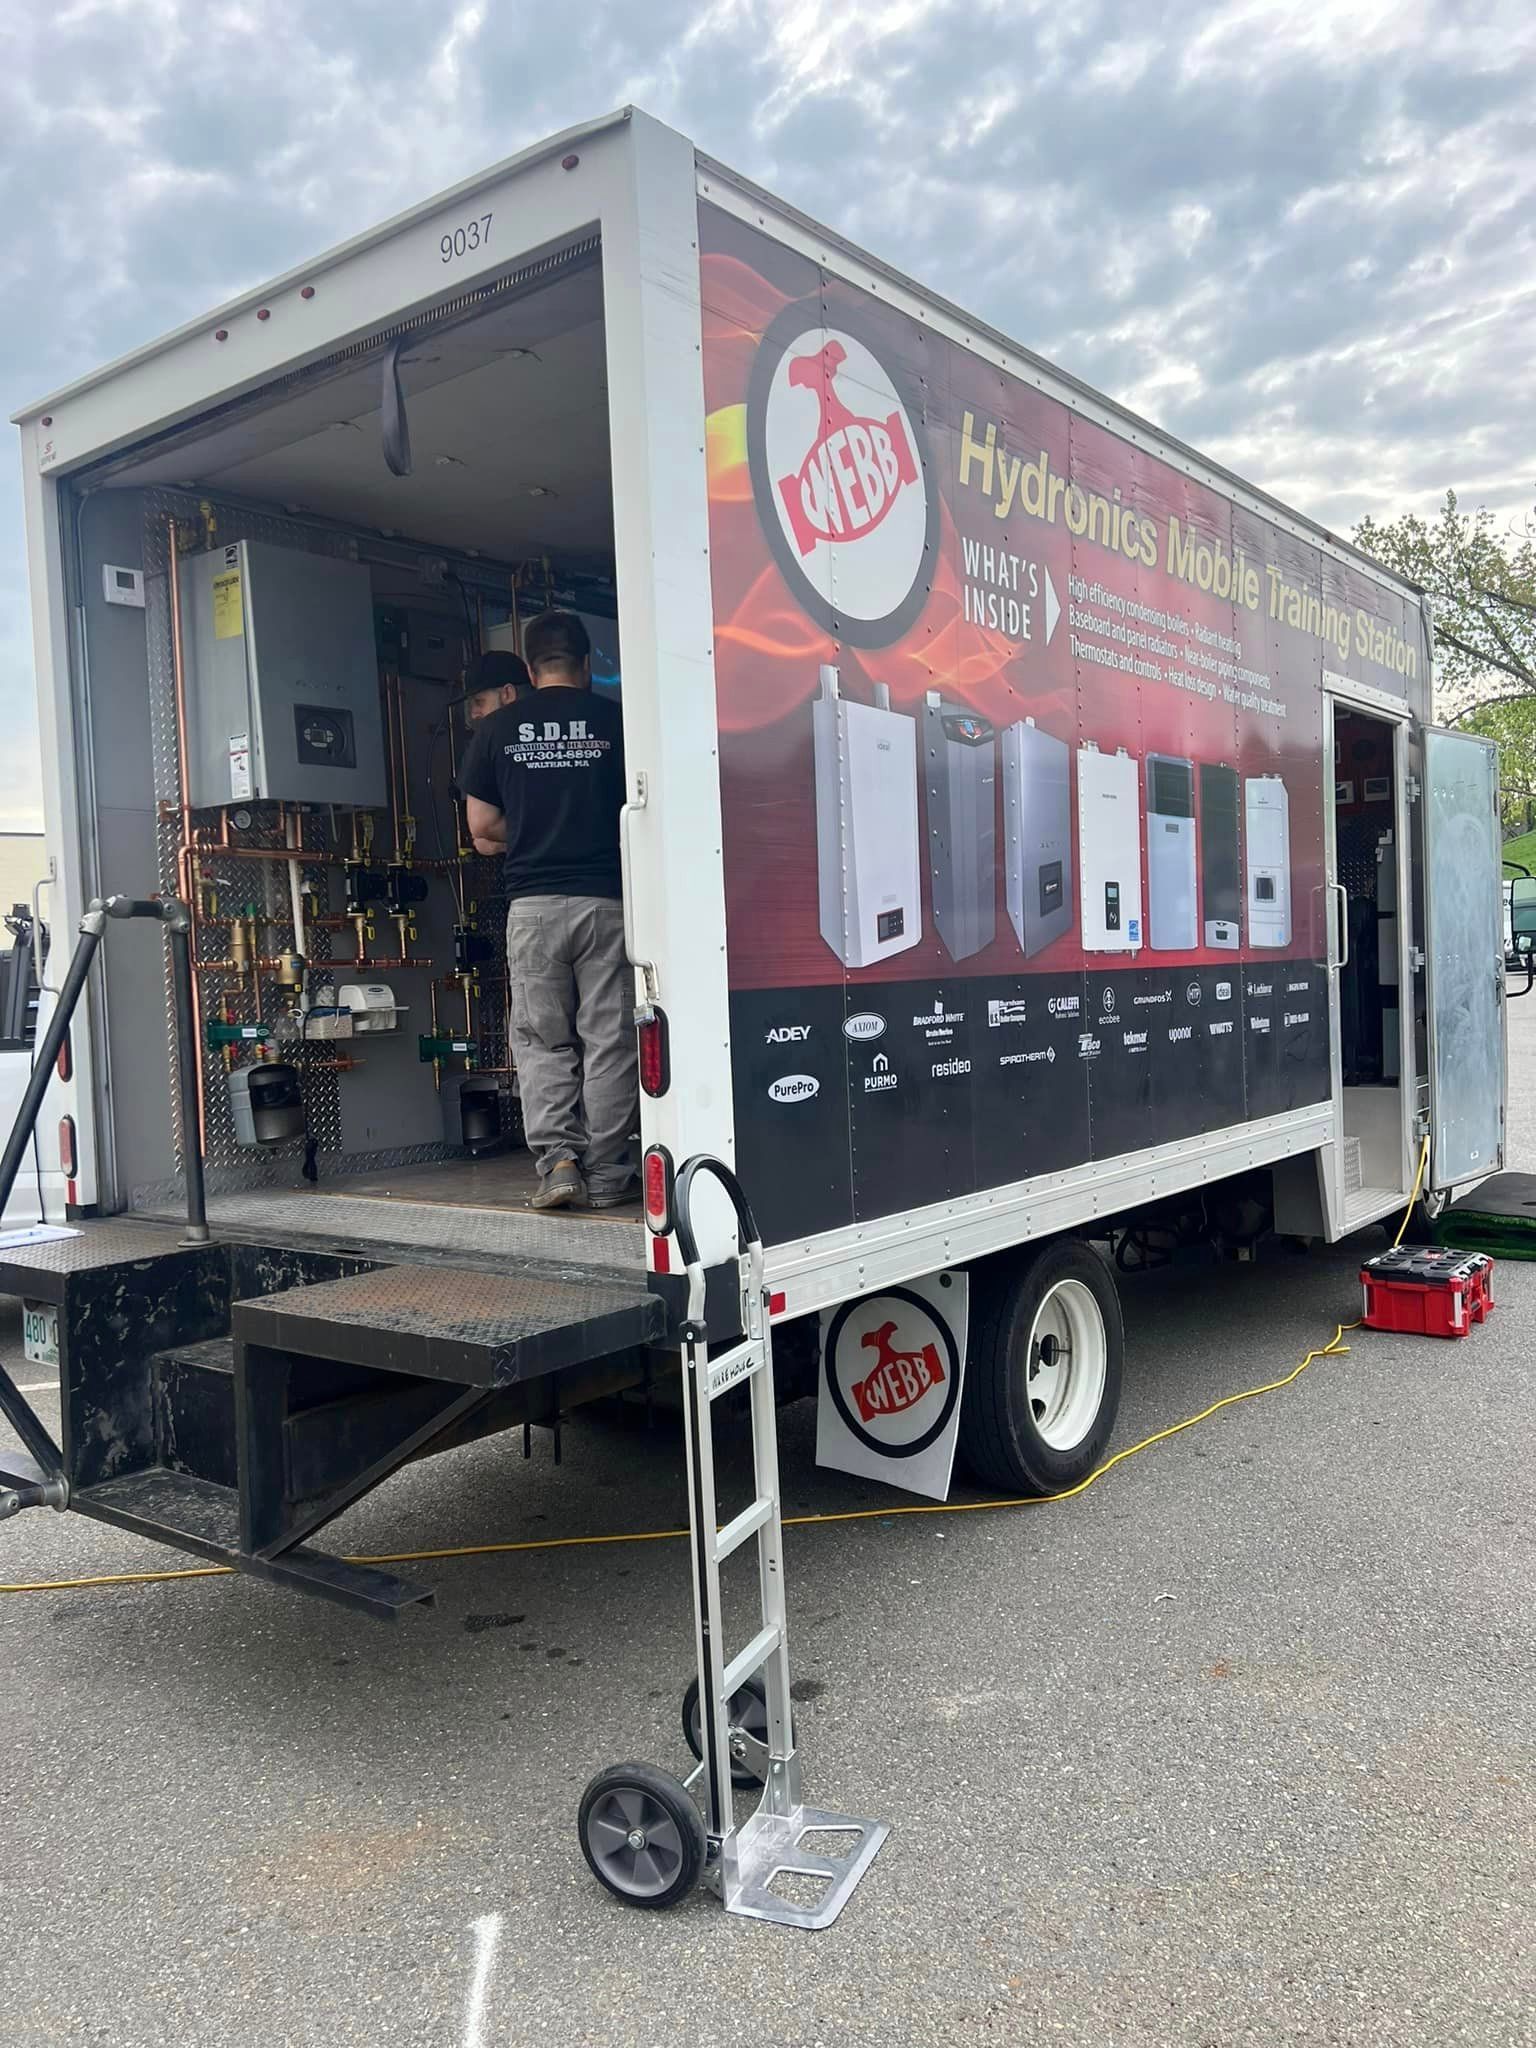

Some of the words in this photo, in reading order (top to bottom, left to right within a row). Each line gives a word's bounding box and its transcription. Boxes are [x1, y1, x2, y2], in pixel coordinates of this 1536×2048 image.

[441, 213, 492, 263] 9037
[801, 425, 899, 534] WEBB
[959, 411, 1158, 567] Hydronics
[1167, 516, 1260, 610] Mobile
[1266, 564, 1350, 661] Training
[1355, 609, 1416, 679] Station
[962, 537, 1038, 597] WHAT'S
[964, 585, 1032, 640] INSIDE
[1068, 573, 1088, 603] High
[1089, 582, 1126, 618] efficiency
[1127, 601, 1167, 632] condensing
[1167, 611, 1189, 636] boilers
[1194, 622, 1219, 648] Radiant
[1218, 631, 1241, 660] heating
[1069, 604, 1110, 637] Baseboard
[1111, 622, 1126, 642] and
[1127, 630, 1146, 649] panel
[1148, 634, 1178, 659] radiators
[1218, 658, 1238, 683] piping
[1238, 667, 1271, 690] components
[1069, 634, 1118, 668] Thermostats
[1119, 652, 1133, 672] and
[1134, 660, 1161, 681] controls
[1168, 665, 1184, 687] Heat
[1184, 669, 1197, 691] loss
[1197, 675, 1217, 701] design
[1222, 682, 1240, 704] Water
[1240, 691, 1260, 714] quality
[1260, 697, 1286, 717] treatment
[519, 720, 594, 742] S.D.H.
[504, 743, 555, 754] PLUMBING
[557, 742, 566, 750] &
[567, 740, 611, 750] HEATING
[513, 749, 602, 762] 617-304-8890
[1056, 996, 1079, 1011] CALEFFI
[1133, 994, 1166, 1005] GRUNDFOS
[852, 1021, 878, 1033] AXIOM
[913, 1015, 944, 1026] BRADFORD
[945, 1013, 965, 1023] WHITE
[1099, 1014, 1120, 1024] ecobee
[765, 1026, 811, 1043] ADEY
[1169, 1026, 1192, 1043] uponor
[1209, 1021, 1233, 1035] WATTS
[1078, 1033, 1101, 1051] Taco
[1123, 1031, 1147, 1045] tekmar
[1000, 1051, 1047, 1066] SPIROTHERM
[931, 1057, 971, 1078] resideo
[774, 1081, 814, 1097] PurePro
[864, 1073, 898, 1089] PURMO
[26, 1313, 46, 1345] 480
[866, 1356, 932, 1410] WEBB
